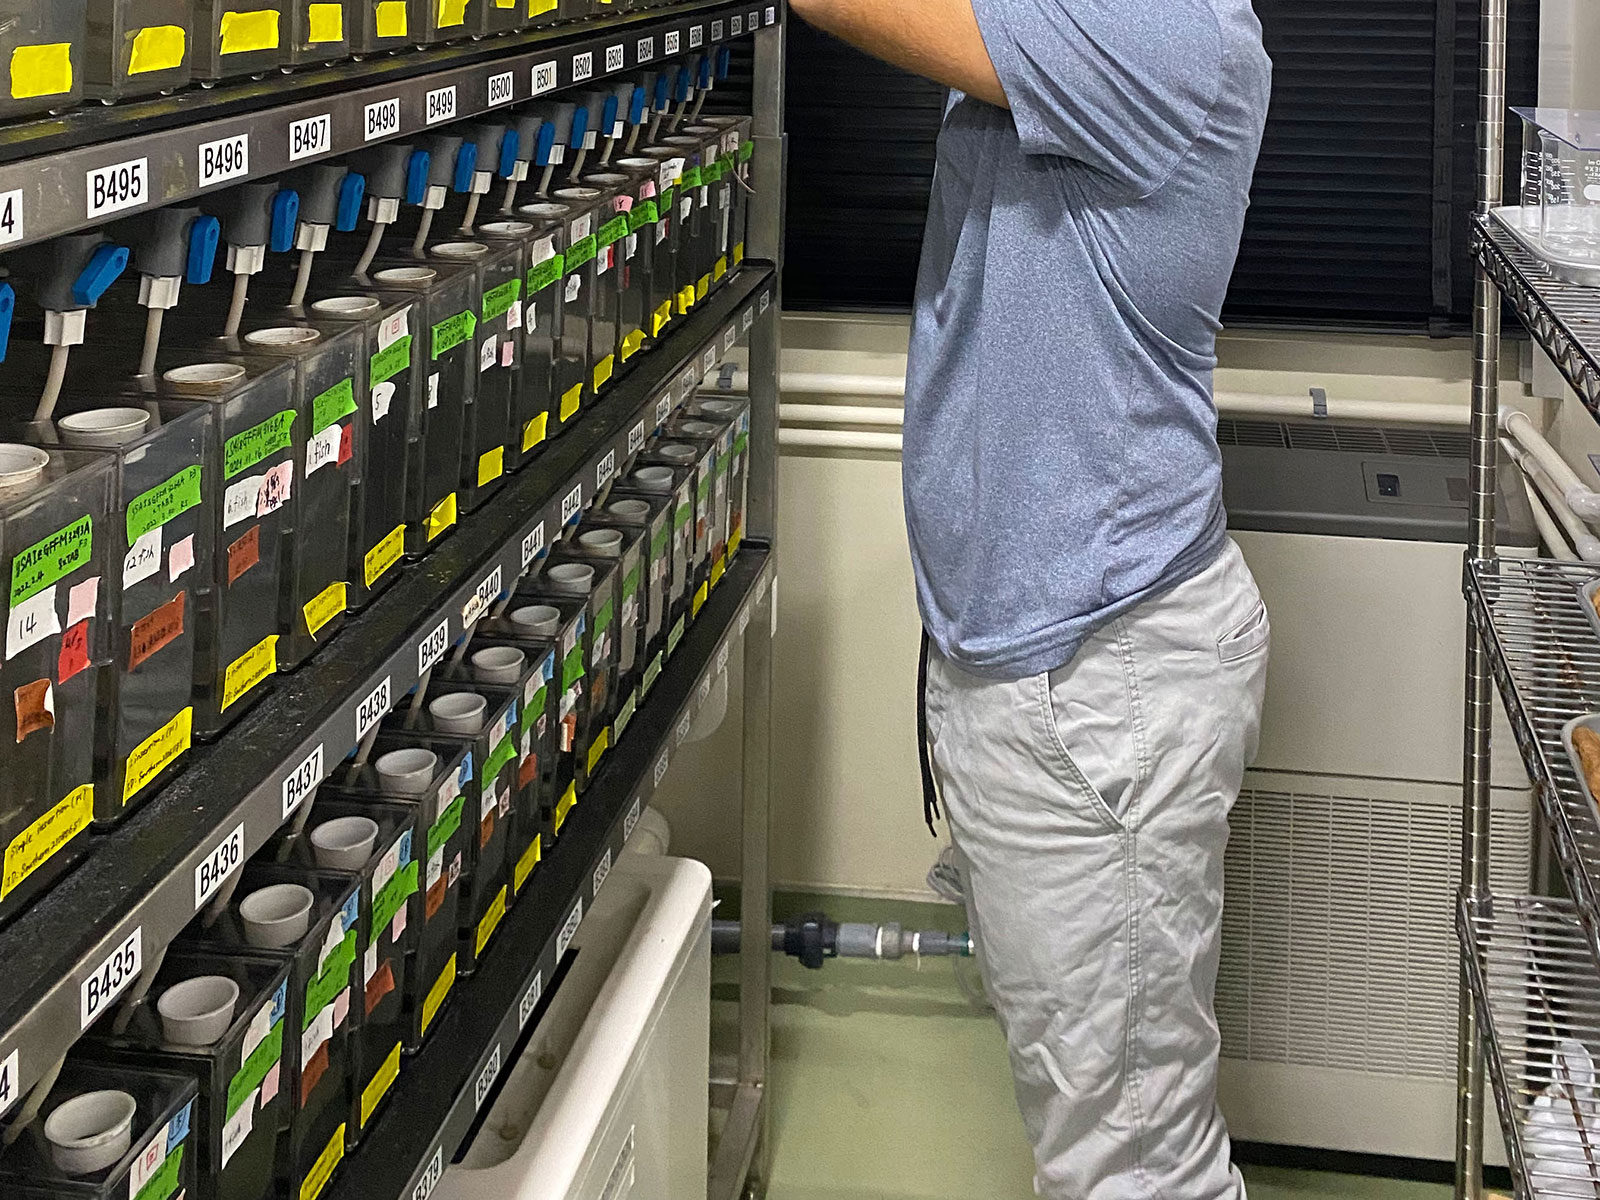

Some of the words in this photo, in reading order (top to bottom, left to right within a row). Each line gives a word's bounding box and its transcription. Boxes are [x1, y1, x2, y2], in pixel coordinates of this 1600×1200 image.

[575, 56, 591, 77] B502
[607, 48, 622, 68] B503
[490, 77, 511, 99] B500
[536, 68, 553, 90] B501
[368, 103, 396, 135] B498
[429, 94, 453, 118] B499
[294, 119, 327, 154] B497
[204, 140, 243, 179] B496
[93, 164, 141, 210] B495
[314, 439, 331, 465] fish
[563, 488, 580, 520] B442
[523, 527, 543, 563] B441
[20, 612, 37, 640] 14
[421, 625, 446, 670] B439
[360, 684, 387, 733] B438
[286, 756, 319, 808] B437
[200, 833, 239, 898] B436
[87, 937, 136, 1018] B435
[478, 1062, 498, 1099] B380
